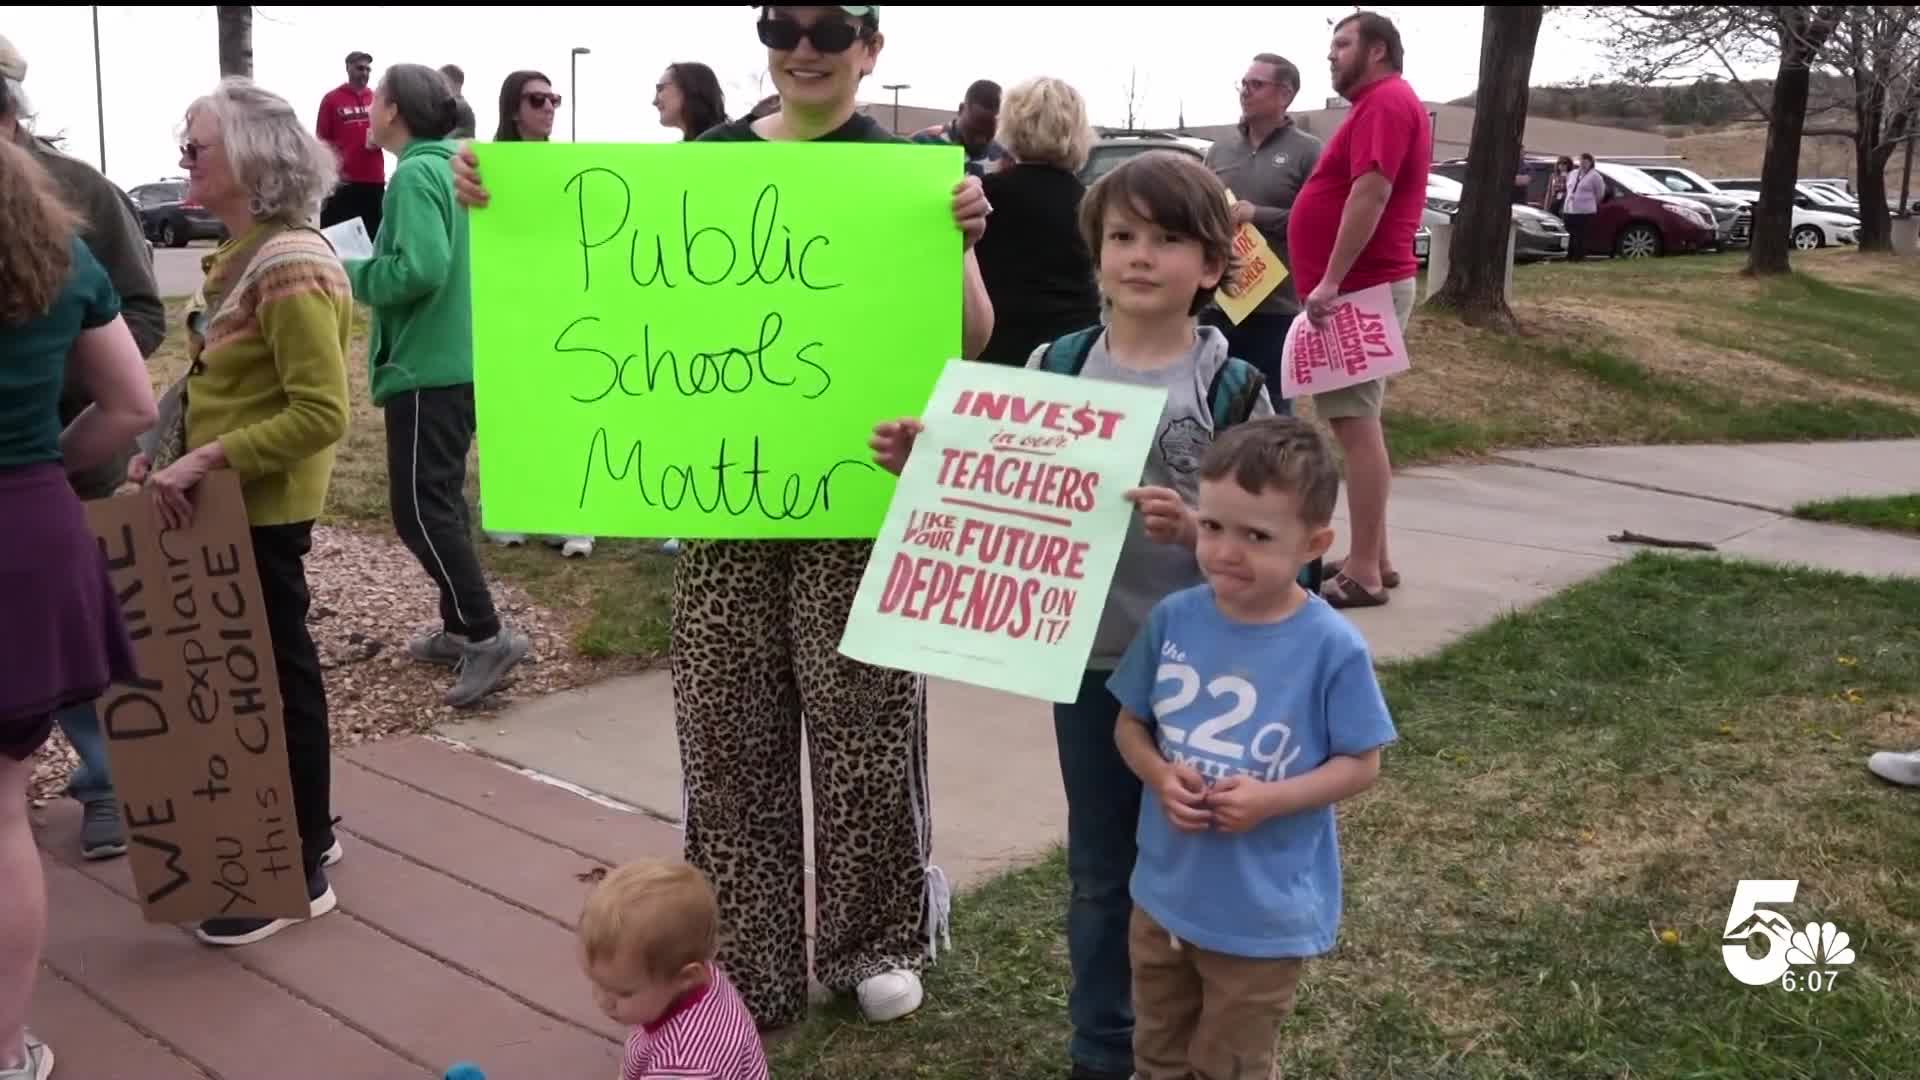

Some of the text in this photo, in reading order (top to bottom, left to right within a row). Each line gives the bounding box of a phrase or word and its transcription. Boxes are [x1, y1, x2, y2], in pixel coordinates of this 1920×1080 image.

[564, 167, 844, 292] Public
[554, 312, 831, 403] Schools
[1355, 307, 1394, 358] LAST
[580, 428, 877, 520] Matter
[936, 448, 1099, 513] TEACHERS
[901, 518, 1091, 580] YOUR FUTURE
[908, 509, 958, 530] LIKE
[877, 551, 1077, 639] DEPENDS ON
[1034, 619, 1070, 645] IT!
[1161, 640, 1187, 662] the
[201, 543, 291, 880] this CHOICE
[193, 754, 230, 801] to
[125, 799, 192, 905] WE
